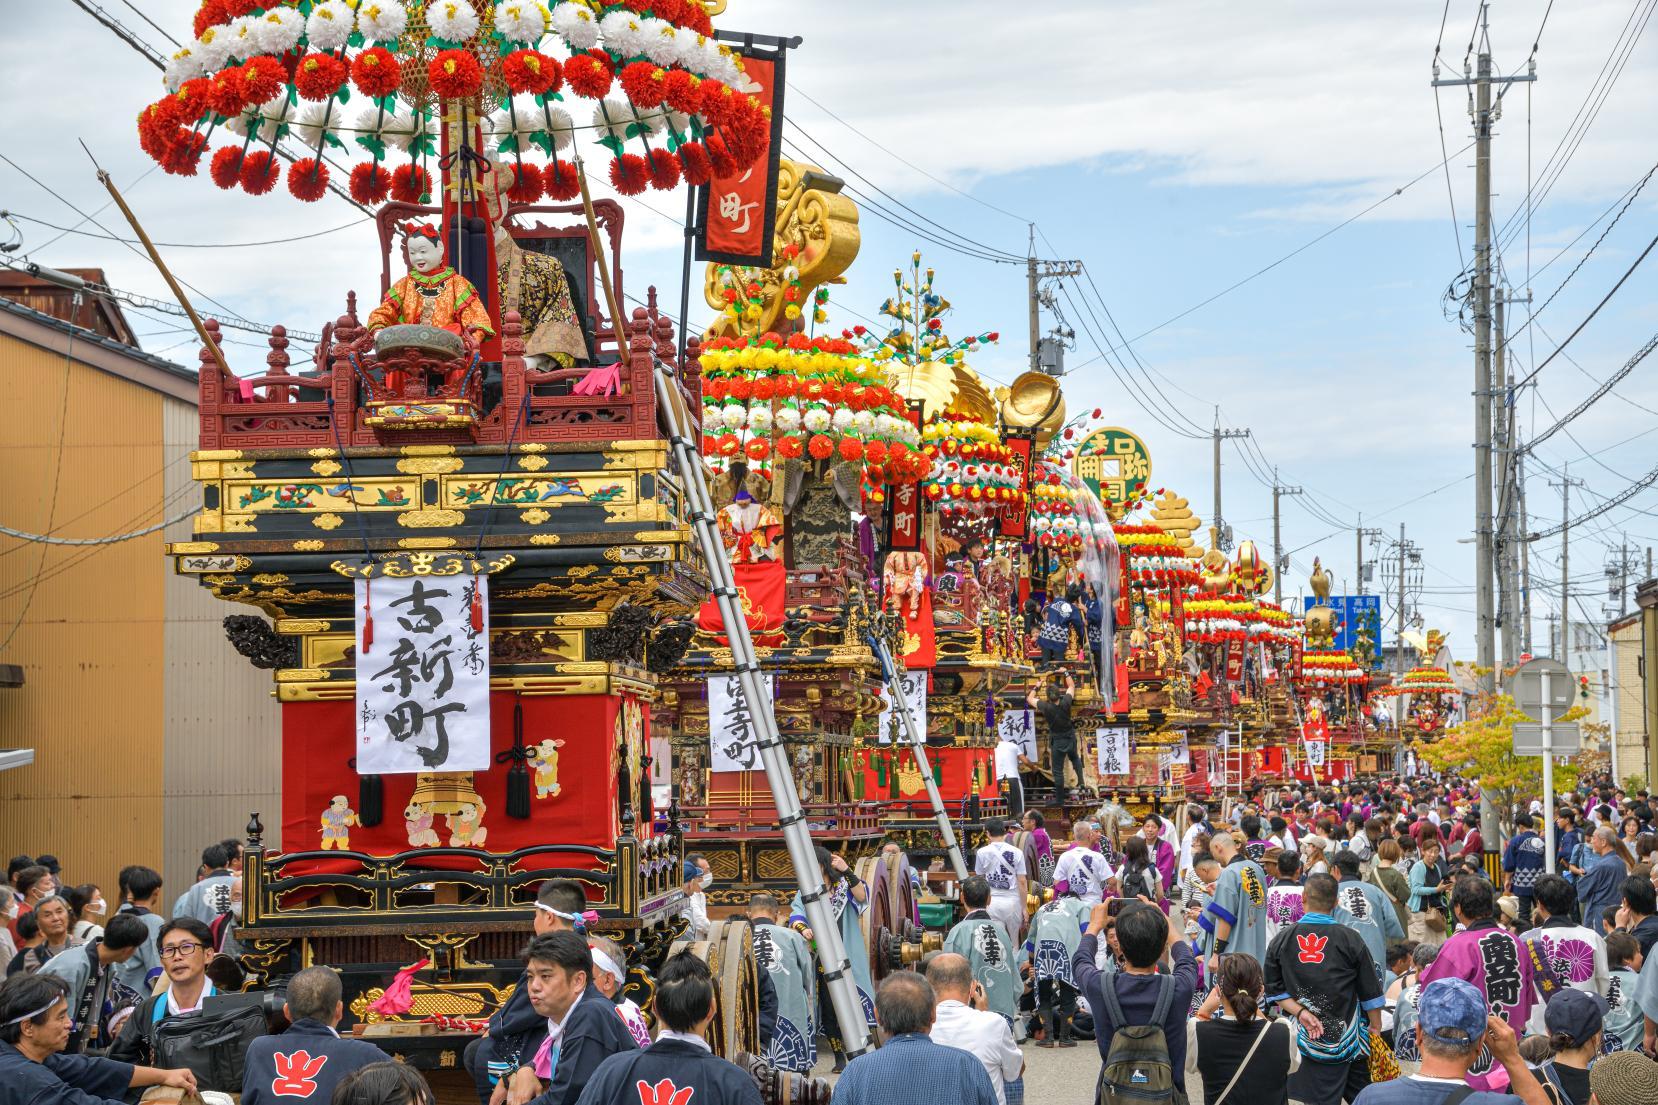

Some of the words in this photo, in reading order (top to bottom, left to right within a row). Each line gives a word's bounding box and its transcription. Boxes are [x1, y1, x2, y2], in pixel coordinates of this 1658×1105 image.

[370, 580, 467, 769] 古新町
[1347, 887, 1366, 919] 法土寺
[982, 924, 1000, 966] 法土寺
